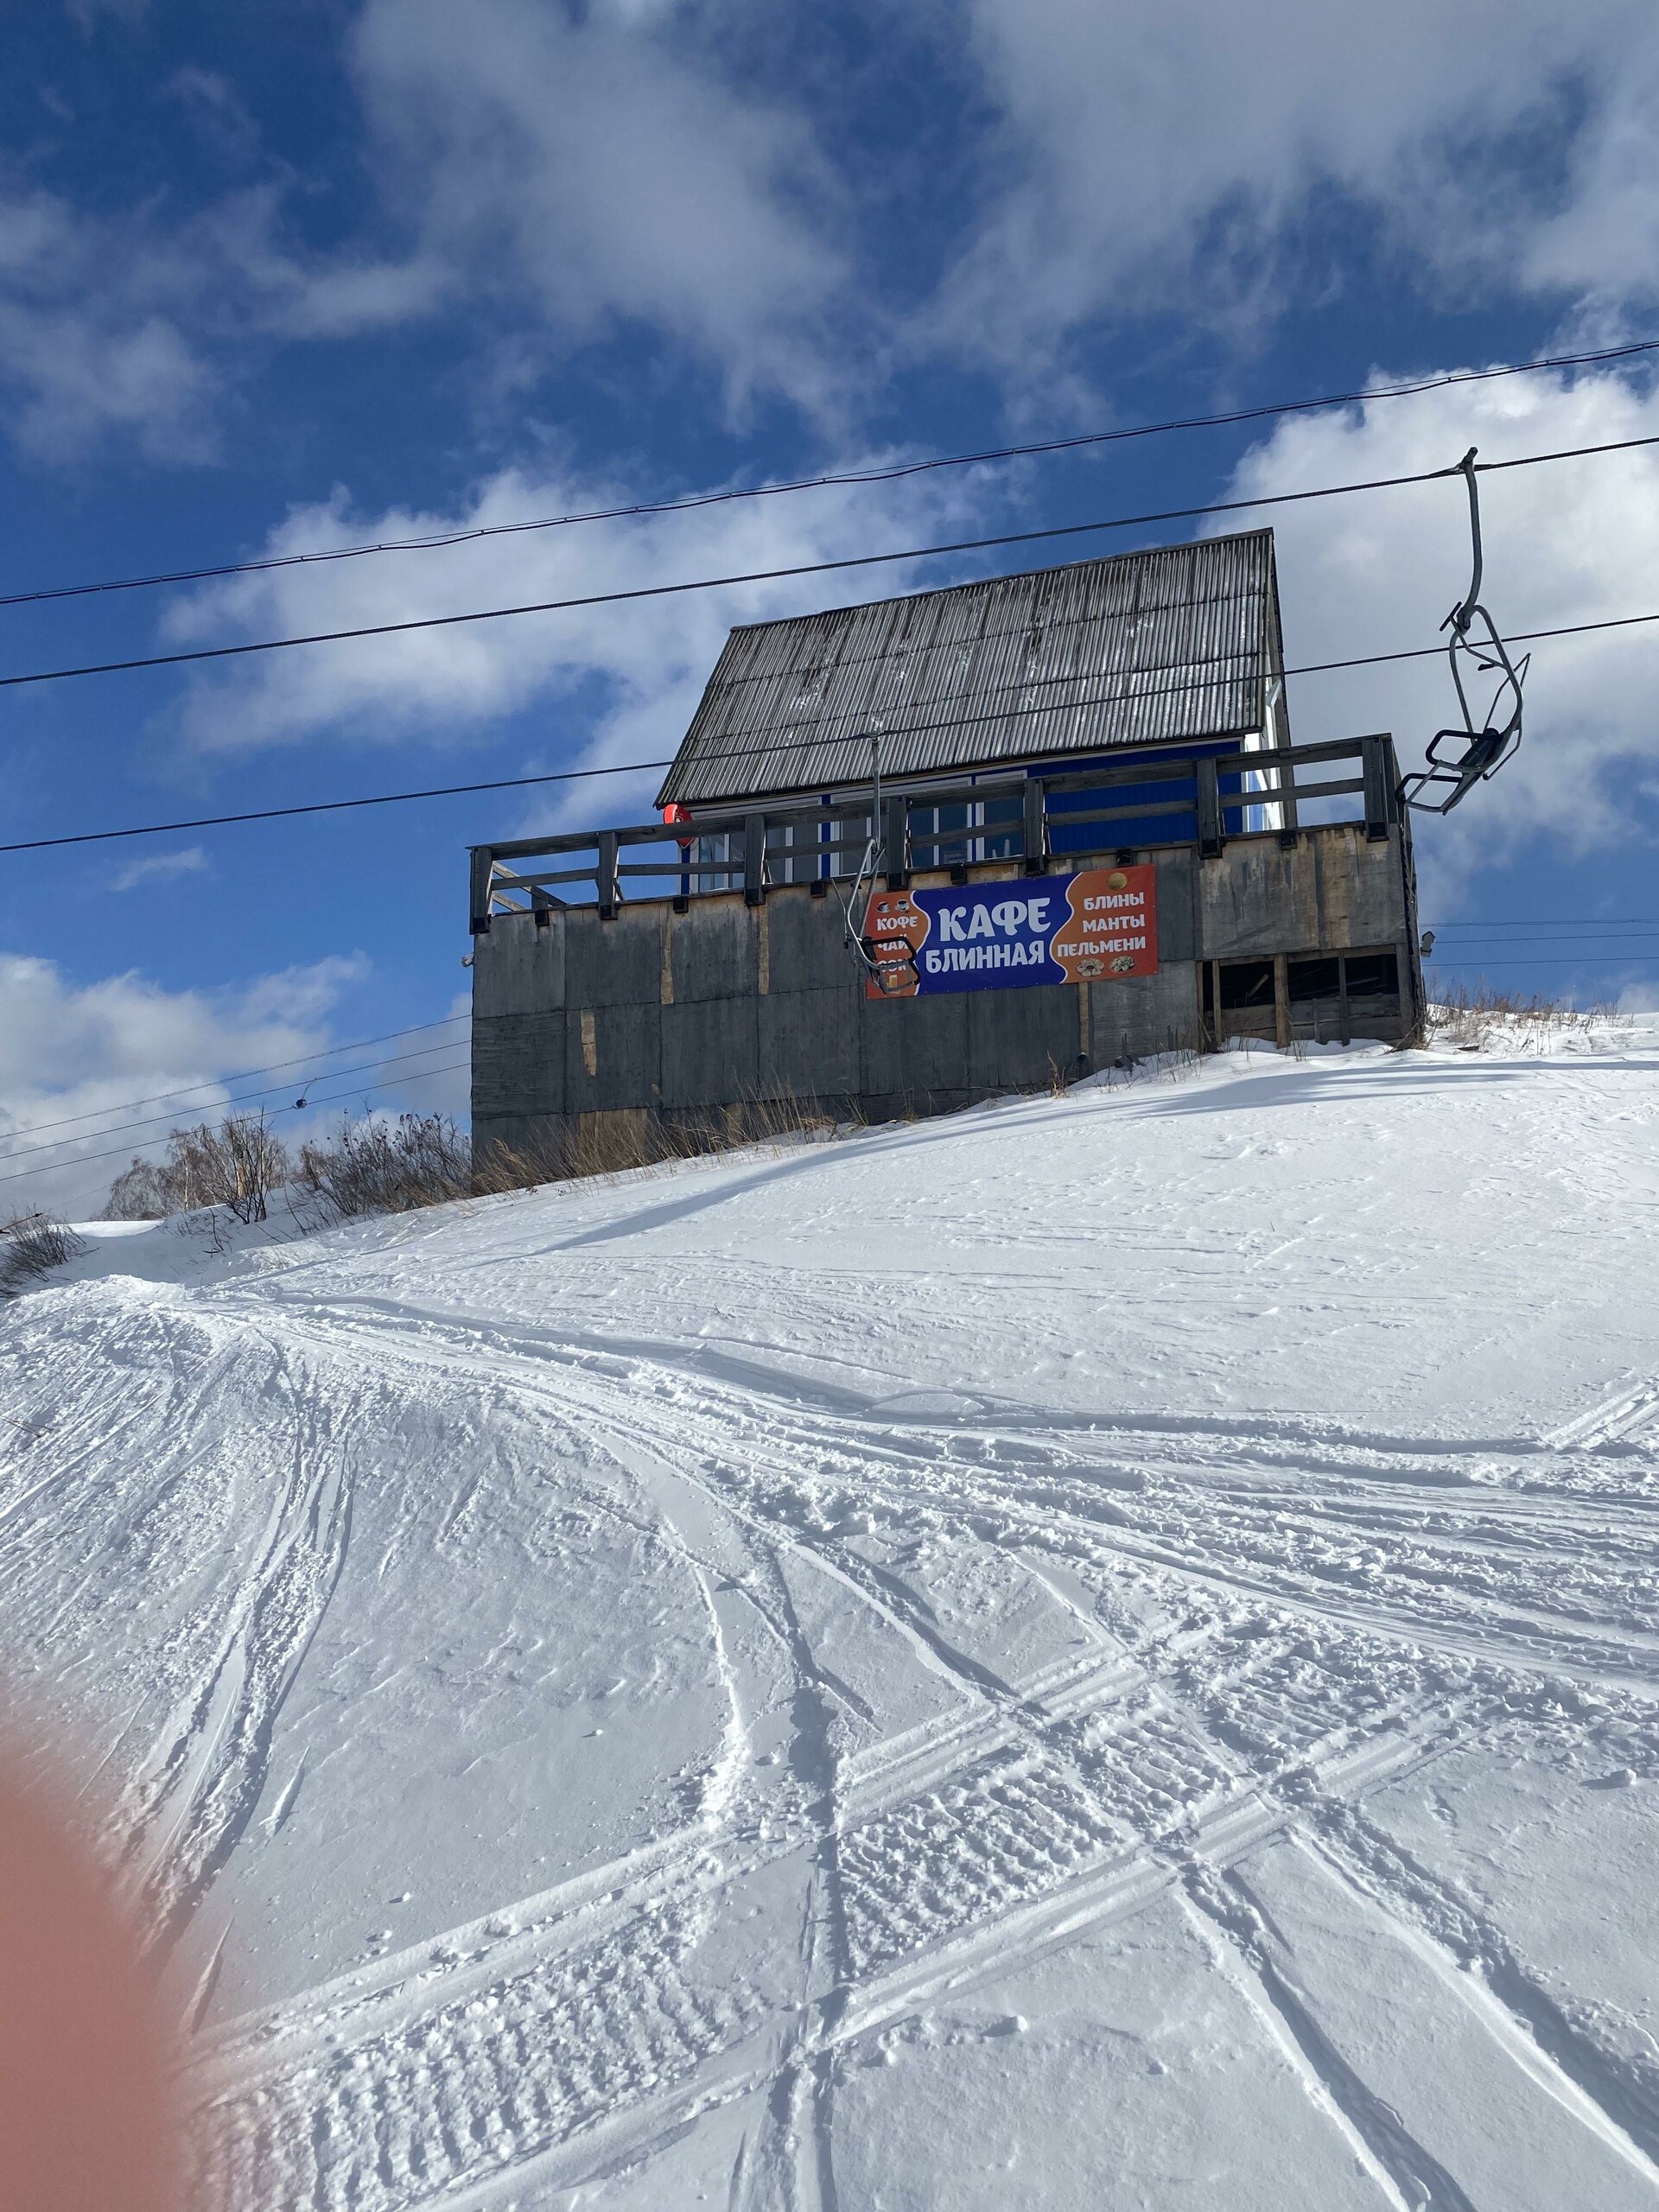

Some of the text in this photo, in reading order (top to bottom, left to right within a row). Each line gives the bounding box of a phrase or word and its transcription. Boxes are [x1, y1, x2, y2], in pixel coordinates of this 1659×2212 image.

[1084, 892, 1145, 911] БЛИНЫ
[876, 915, 918, 931] КОФЕ
[938, 898, 1051, 942] КАФЕ
[1083, 913, 1146, 933] МАНТЫ
[1057, 936, 1147, 957] ПЕЛЬМЕНИ
[925, 940, 1045, 974] БЛИННАЯ
